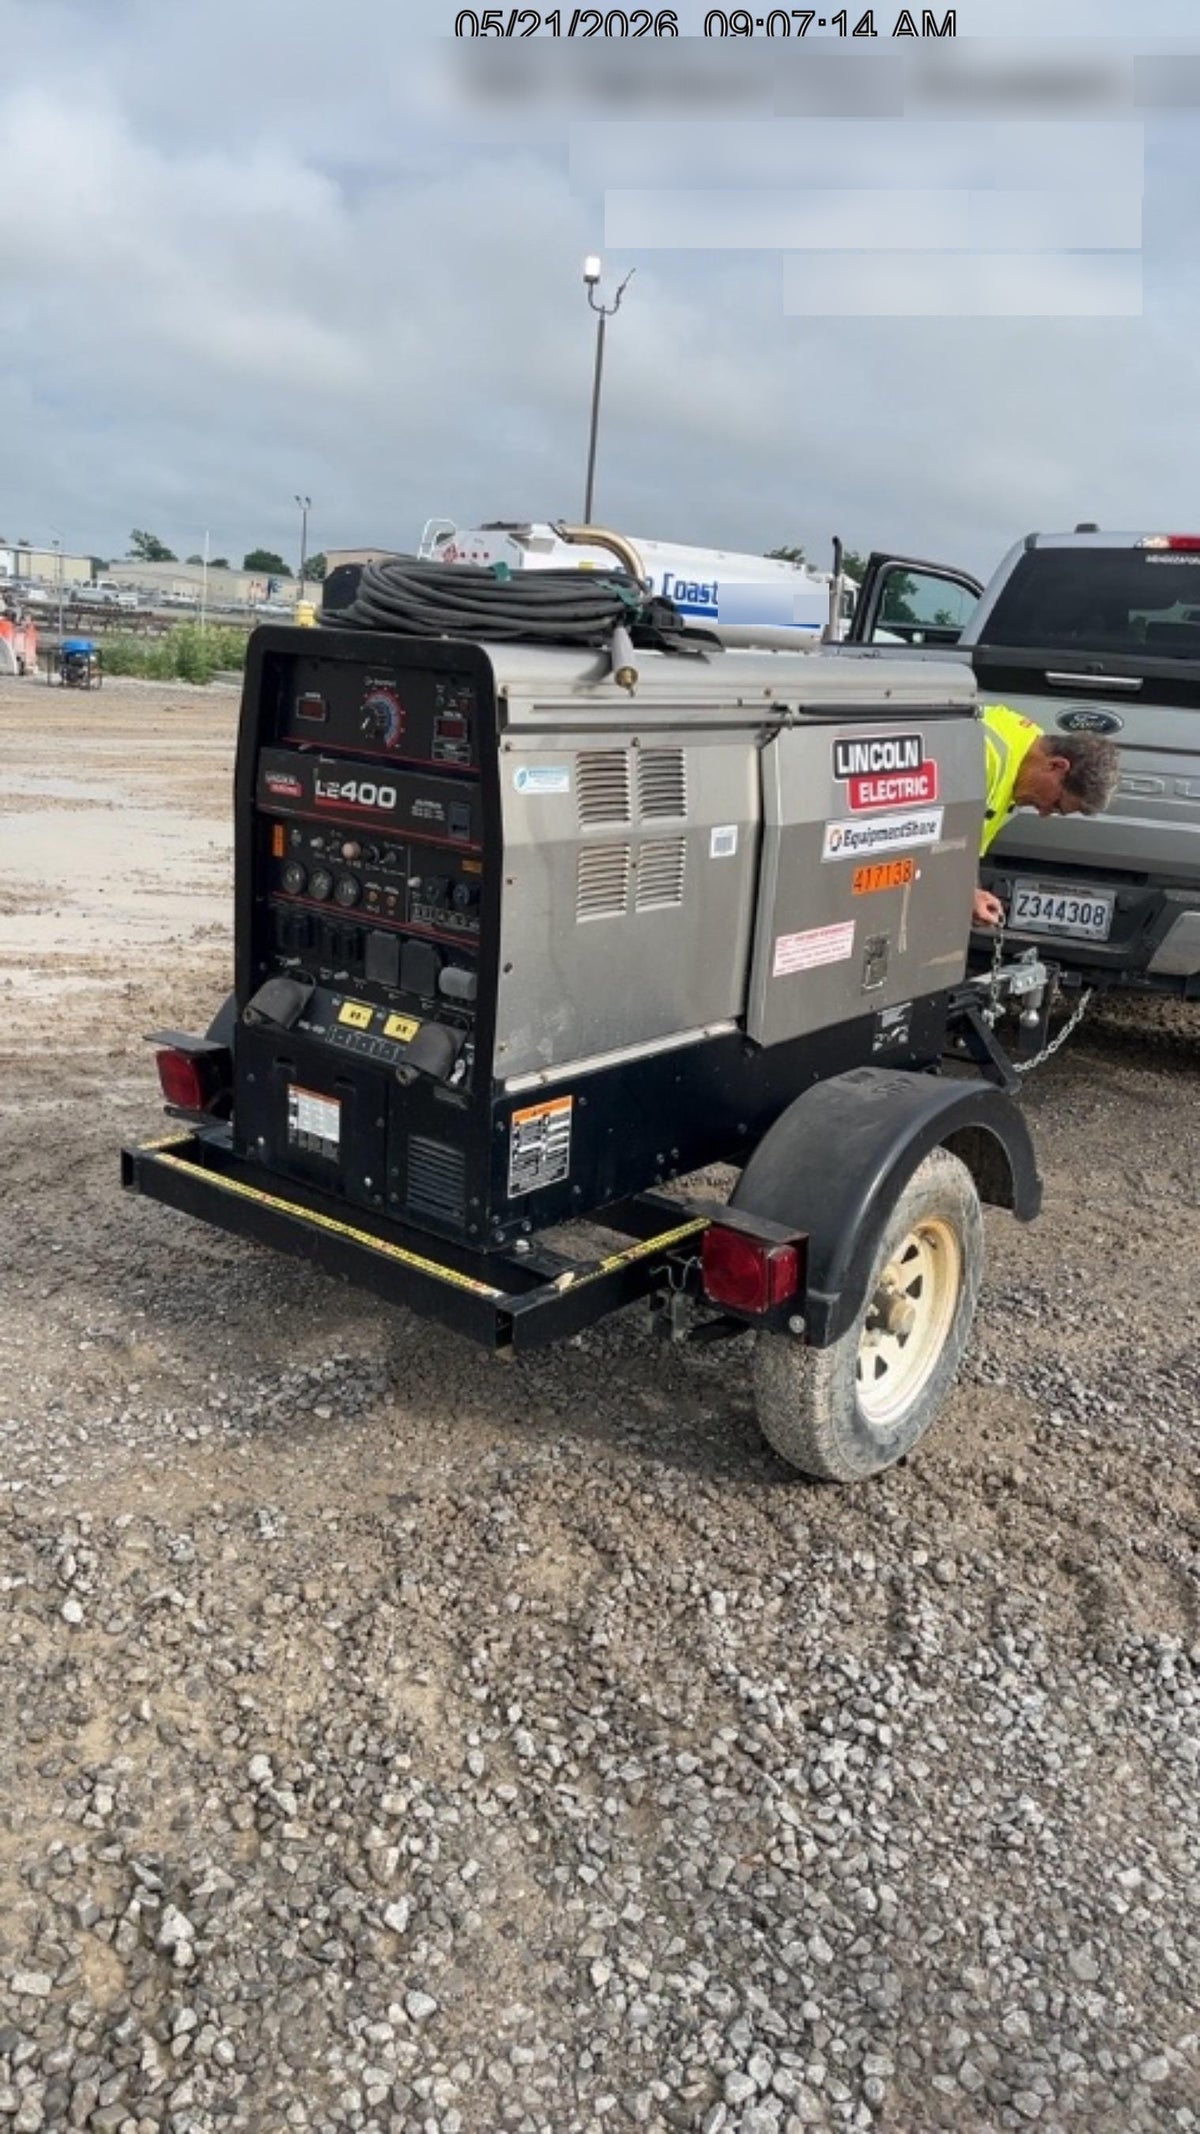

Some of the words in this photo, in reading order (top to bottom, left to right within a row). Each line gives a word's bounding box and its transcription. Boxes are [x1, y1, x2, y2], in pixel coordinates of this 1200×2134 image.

[837, 741, 919, 774] LINCOLN
[858, 776, 928, 803] ELECTRIC
[843, 821, 937, 849] EquipmentShare
[853, 860, 912, 893] 417138
[1017, 894, 1105, 927] Z344308
